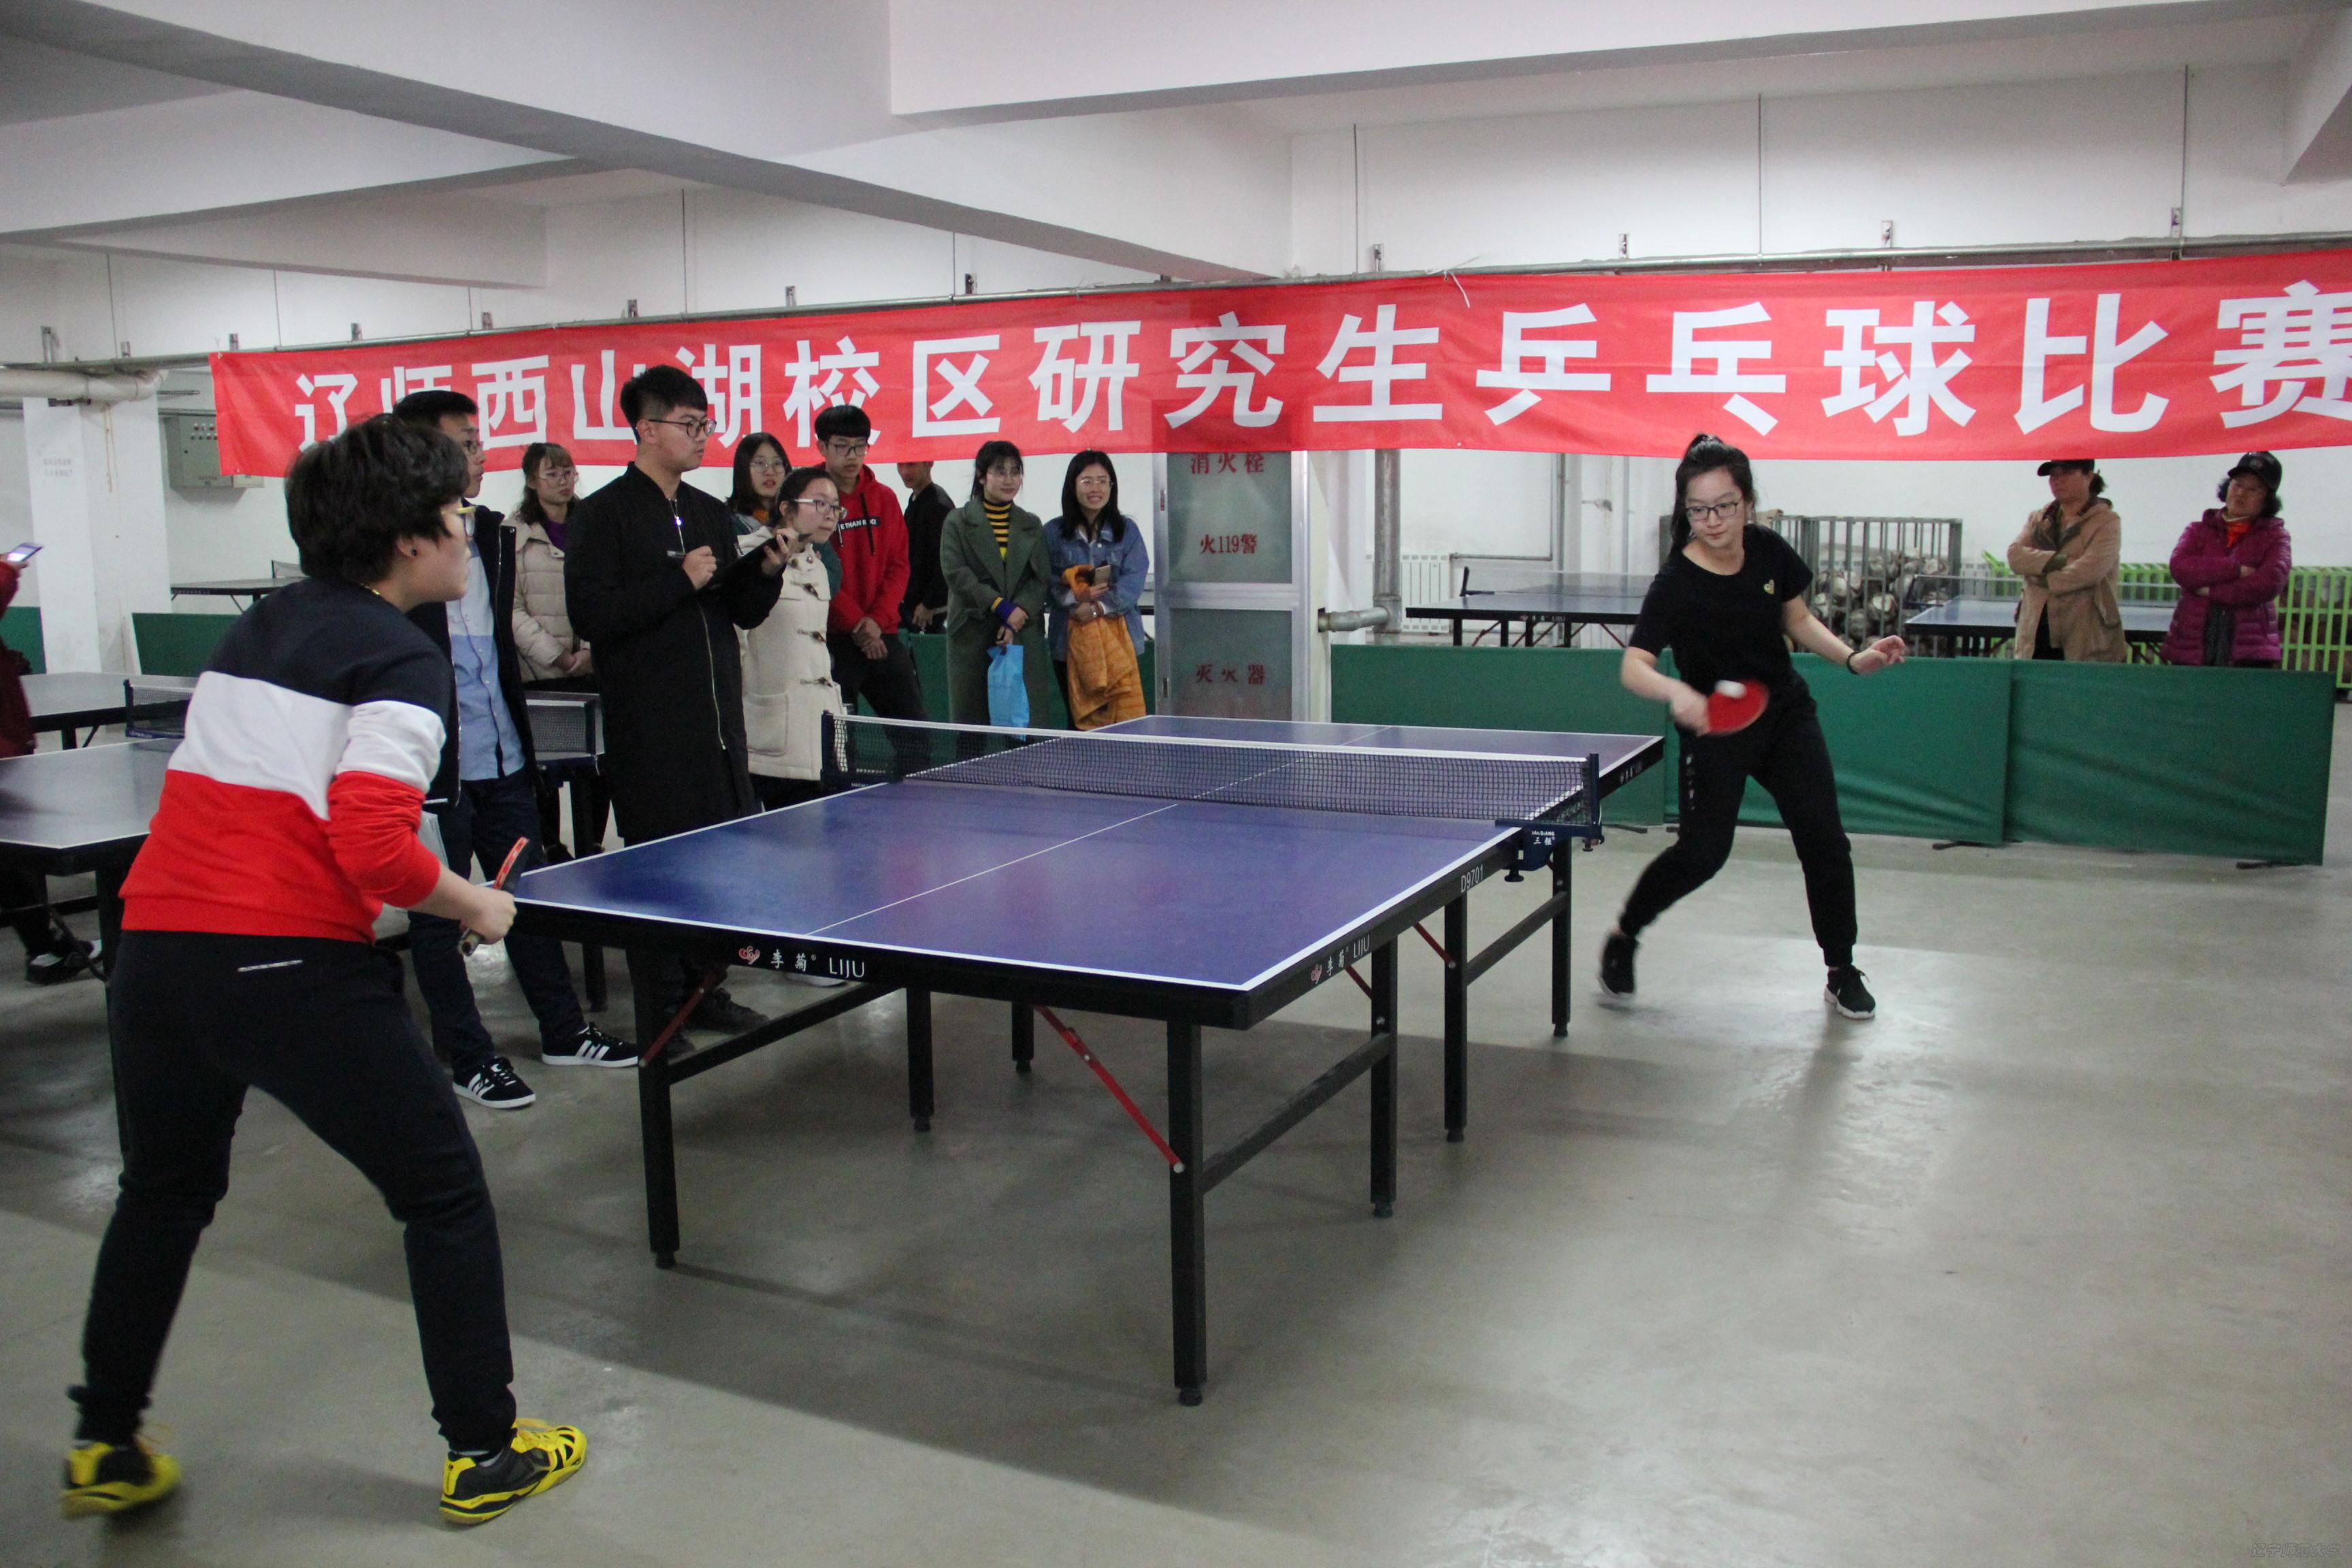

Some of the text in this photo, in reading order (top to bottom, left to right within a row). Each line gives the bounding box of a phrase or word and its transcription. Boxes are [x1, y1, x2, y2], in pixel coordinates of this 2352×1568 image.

[1200, 534, 1257, 554] 火119警
[1196, 664, 1264, 685] 灭火器
[1460, 864, 1483, 893] D9701
[1354, 934, 1370, 958] LIJU
[829, 957, 865, 978] LIJU
